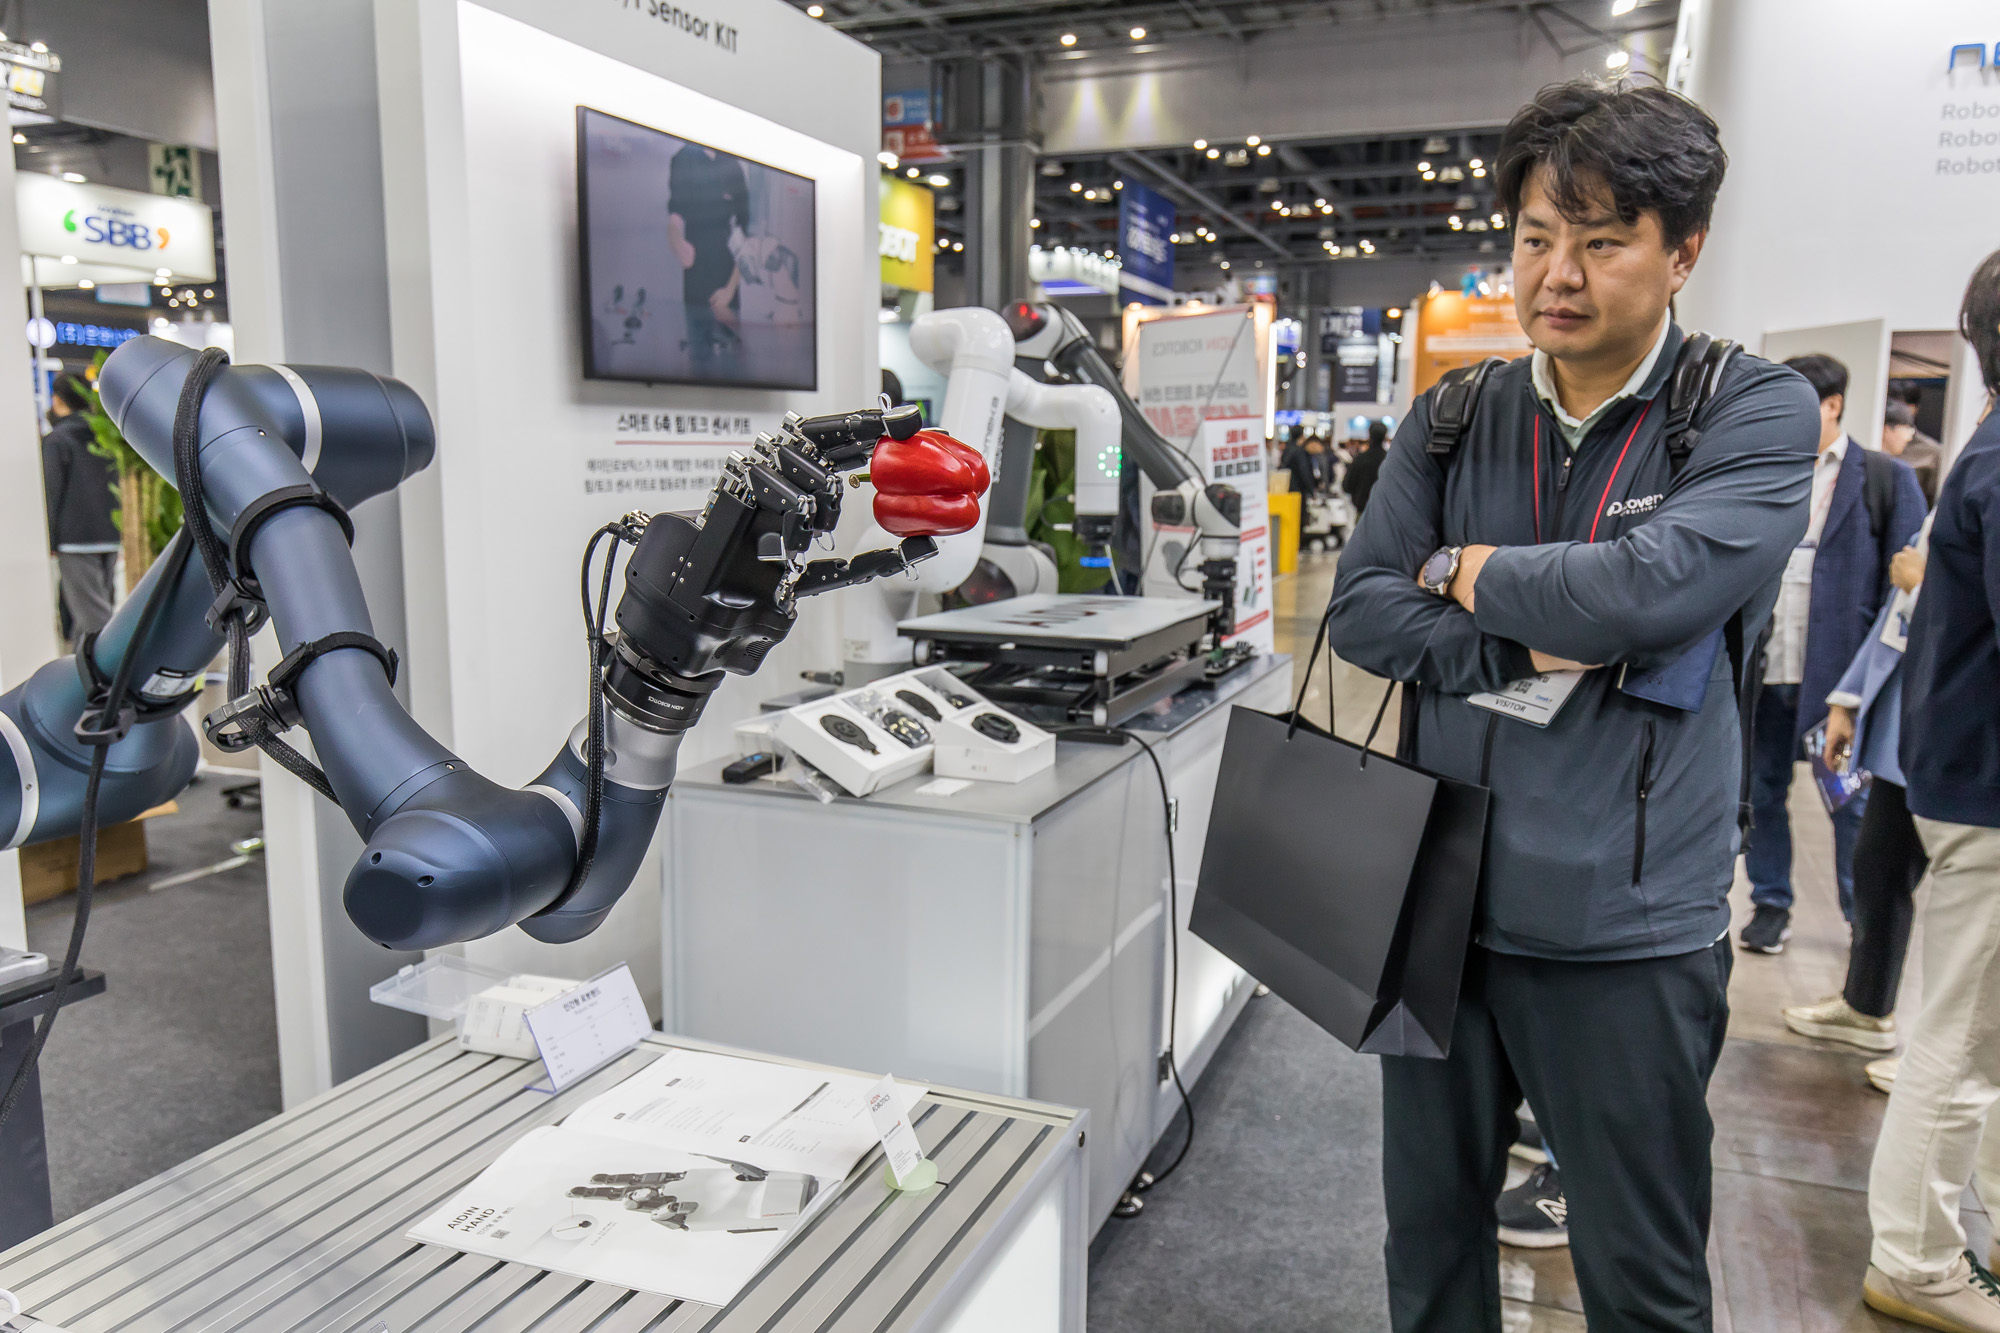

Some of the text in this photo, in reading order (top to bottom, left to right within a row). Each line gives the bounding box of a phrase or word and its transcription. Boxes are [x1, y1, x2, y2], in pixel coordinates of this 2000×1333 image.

[648, 0, 738, 54] Sensor KIT
[85, 215, 151, 250] SBB
[617, 413, 650, 433] 스마트
[1495, 698, 1527, 713] VISITOR
[447, 1206, 479, 1229] AIDIN
[460, 1208, 495, 1232] HAND
